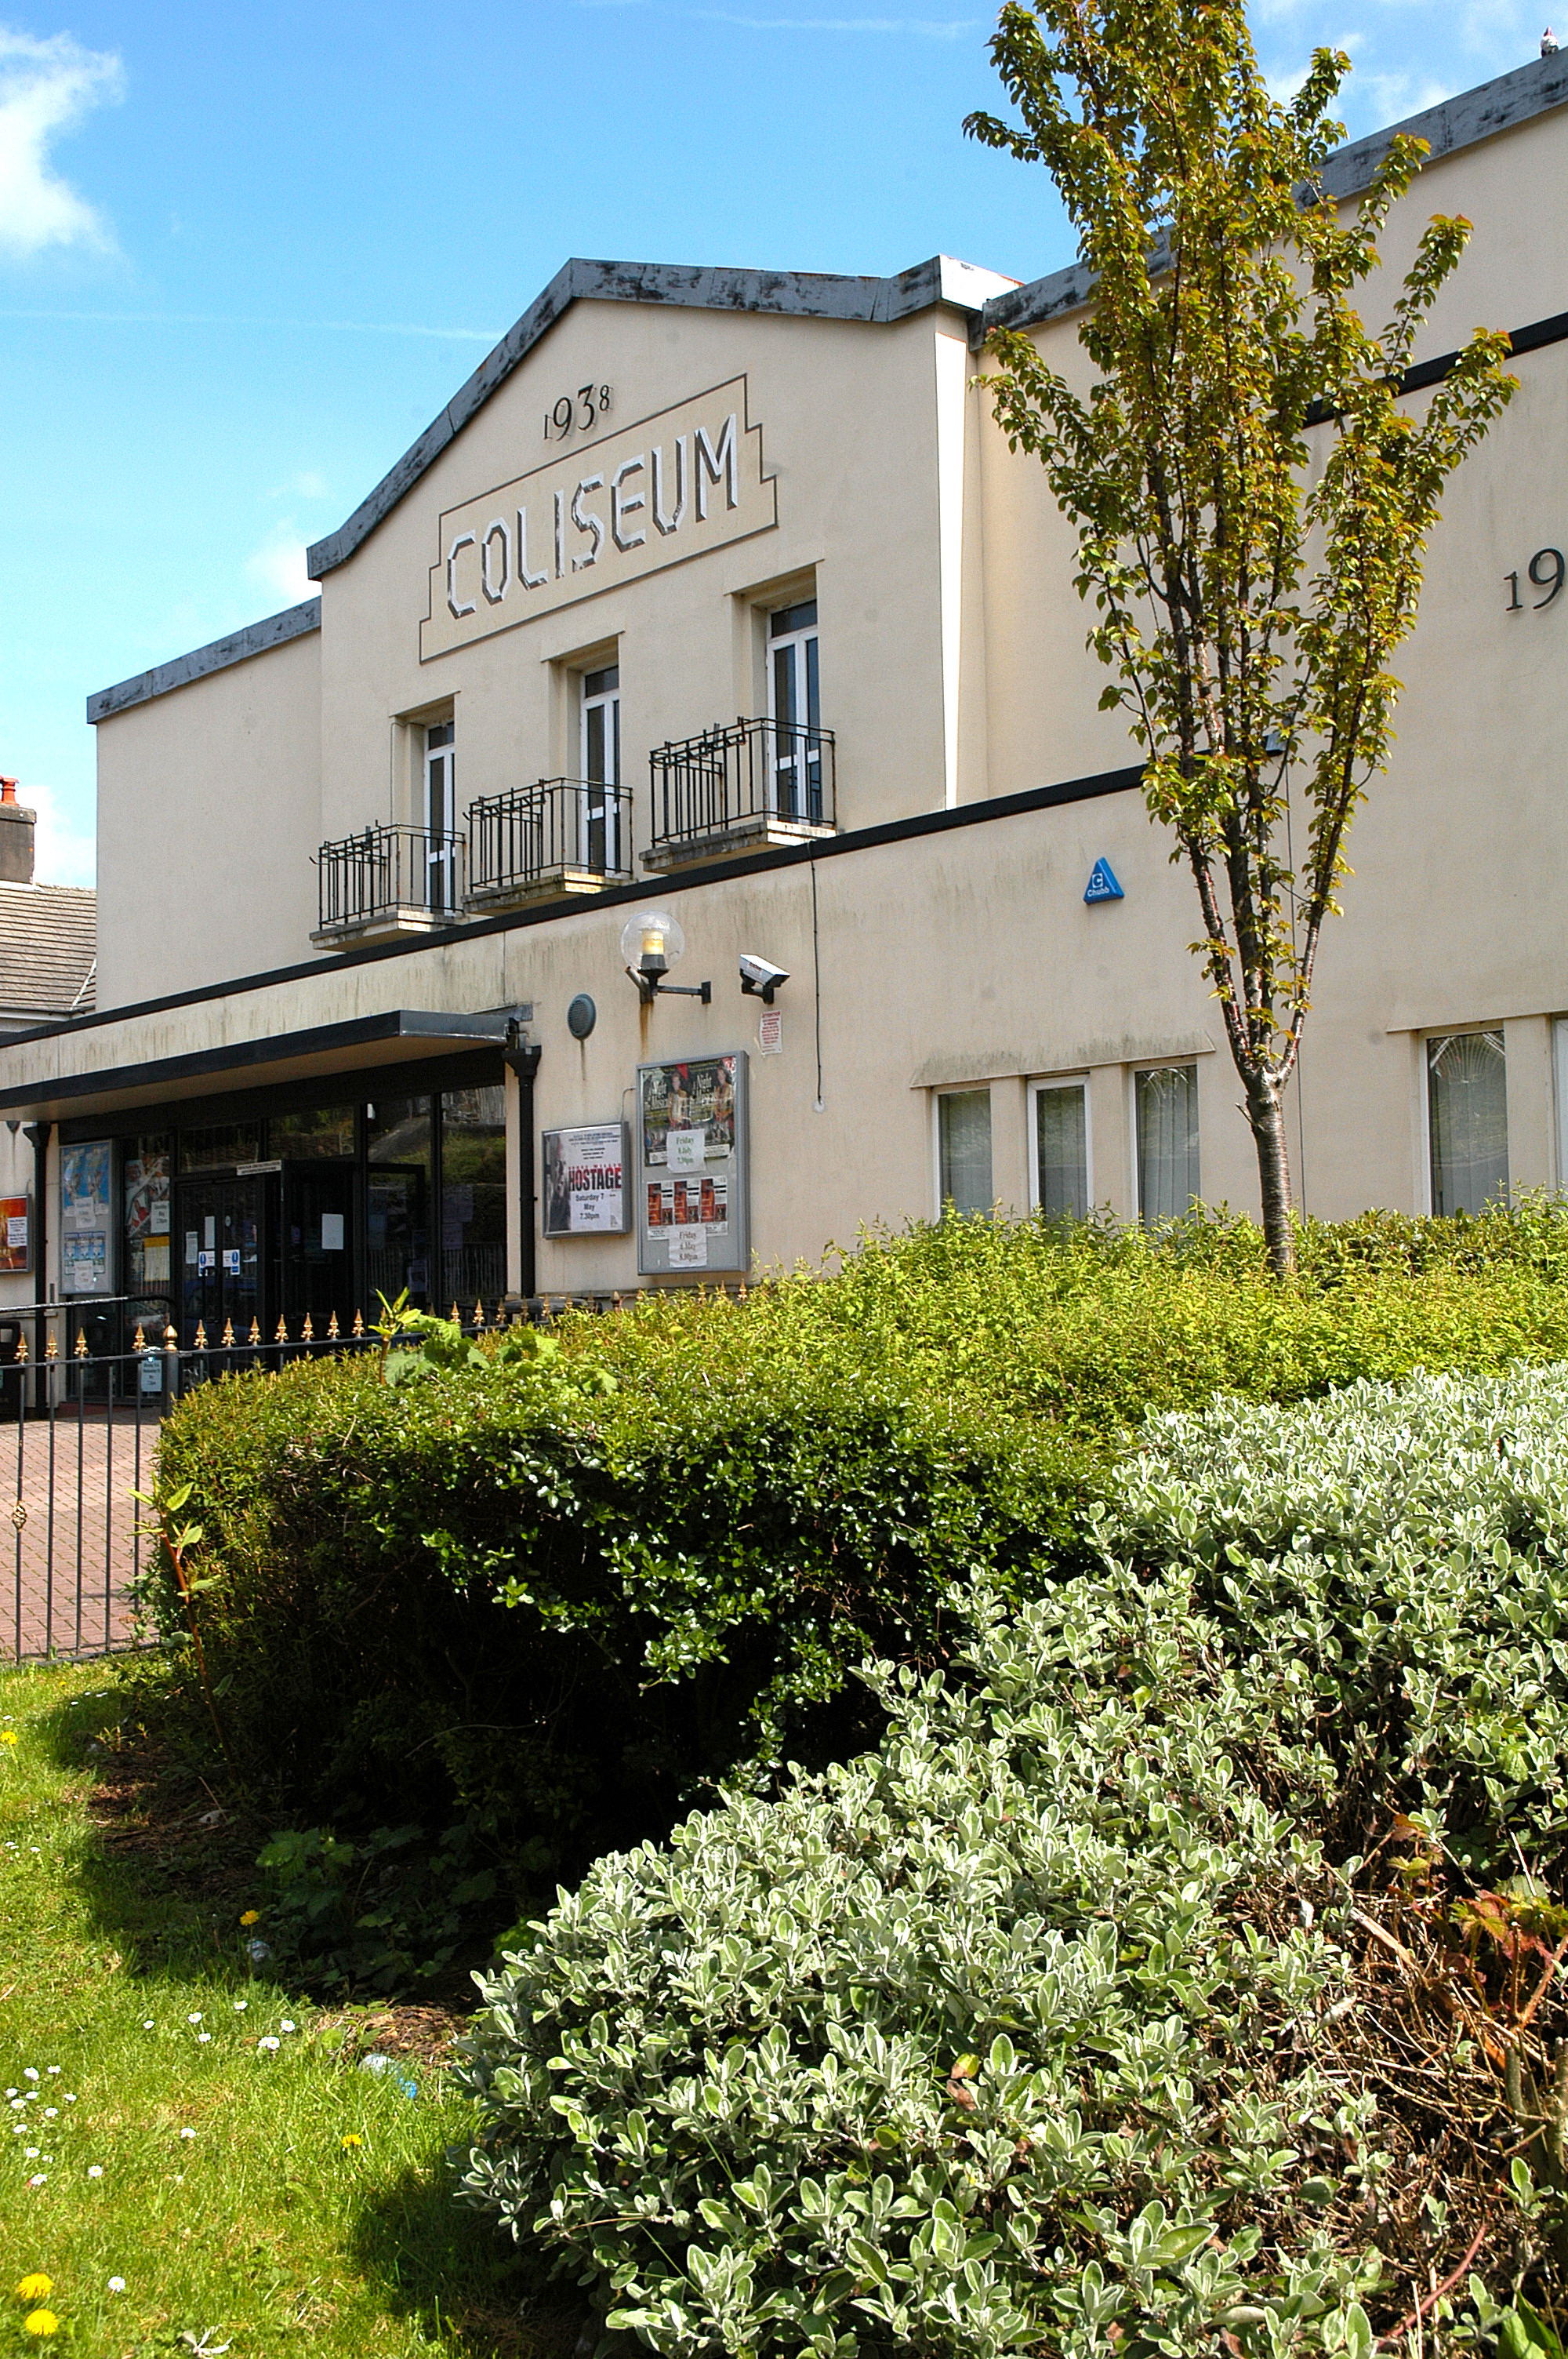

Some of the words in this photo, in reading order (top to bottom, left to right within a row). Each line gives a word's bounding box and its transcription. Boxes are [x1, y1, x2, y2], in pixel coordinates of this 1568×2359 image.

[543, 384, 612, 441] 1938
[447, 413, 738, 620] COLISEUM
[1503, 547, 1565, 611] 19
[676, 1136, 694, 1145] Friday
[568, 1167, 622, 1191] HOSTAGE
[575, 1194, 600, 1202] Saturday
[679, 1231, 697, 1240] Friday
